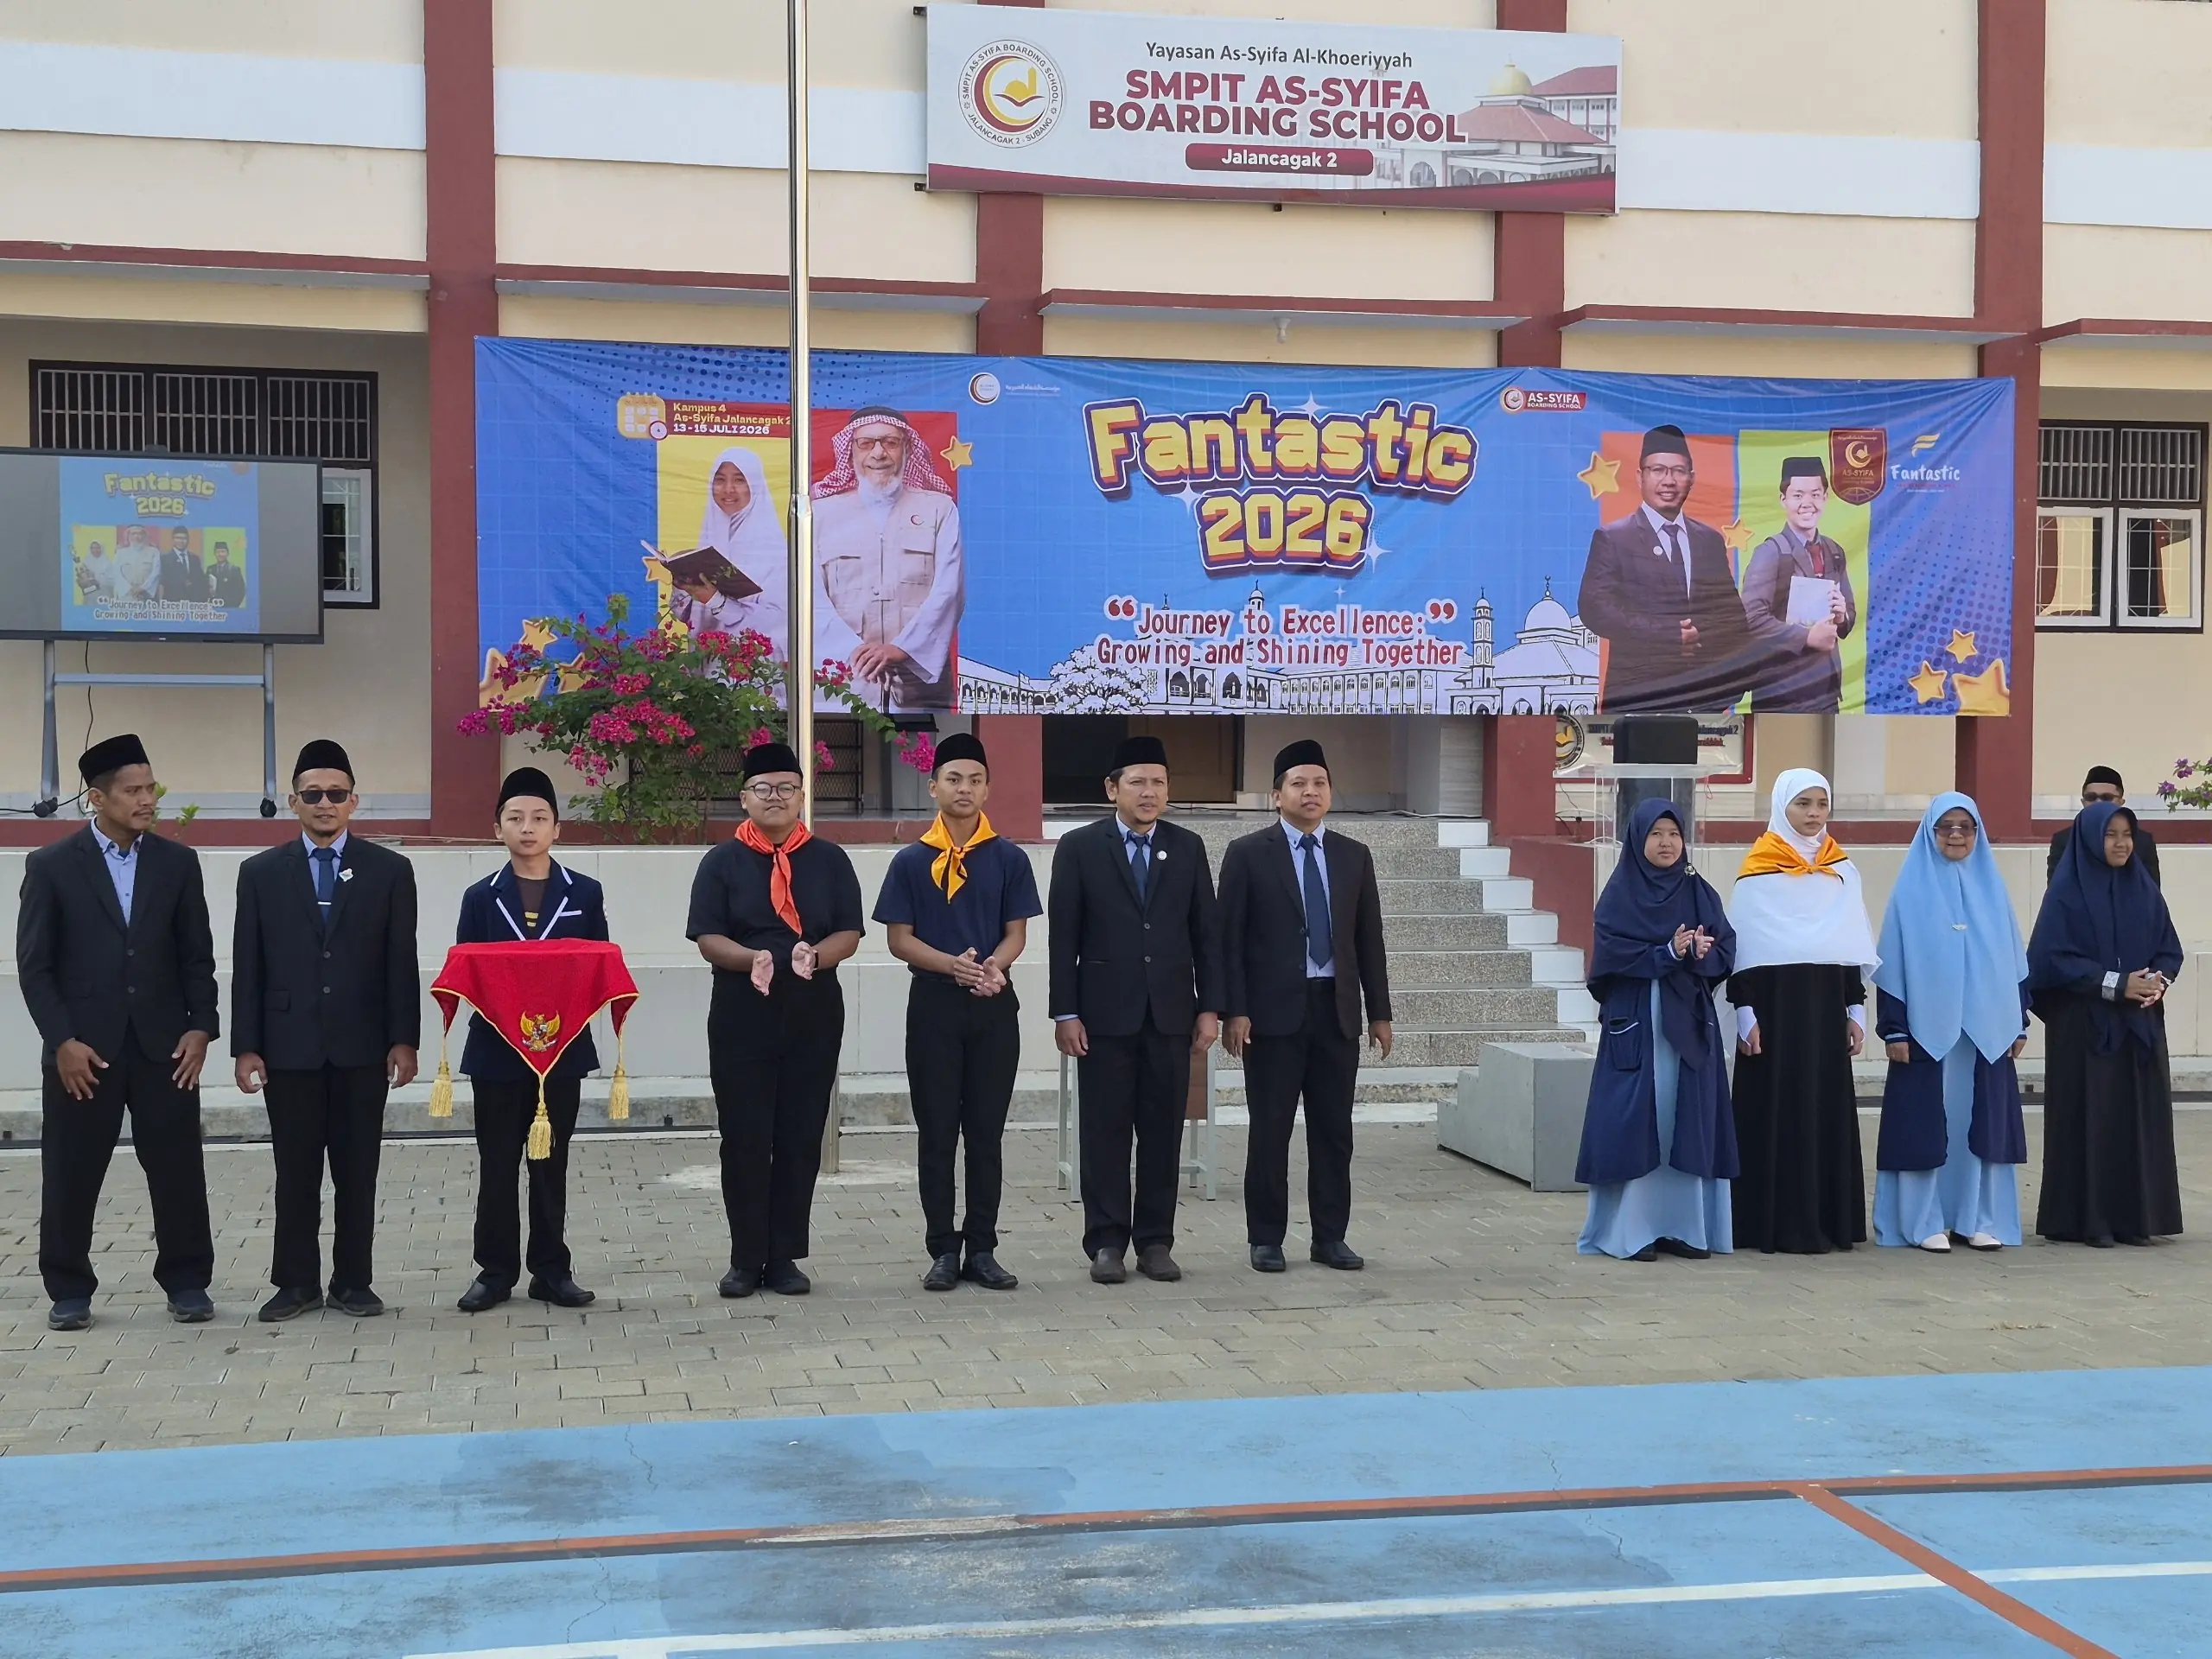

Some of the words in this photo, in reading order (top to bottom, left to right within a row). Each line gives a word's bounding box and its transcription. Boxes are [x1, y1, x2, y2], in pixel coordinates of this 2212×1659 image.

[1146, 41, 1215, 61] Yayasan
[1220, 45, 1287, 65] As-Syifa
[1293, 48, 1413, 71] Al-Khoeriyyah
[963, 73, 972, 99] SMPIT
[969, 45, 1001, 72] AS-SYIFA
[1003, 44, 1046, 67] BOARDING
[1045, 67, 1059, 104] SCHOOL
[1126, 69, 1245, 102] SMPIT
[1255, 74, 1430, 110] AS-SYIFA
[968, 113, 1014, 144] JALANCAGAK
[1025, 117, 1052, 142] SUBANG
[1090, 100, 1297, 137] BOARDING
[1309, 109, 1466, 143] SCHOOL
[1221, 149, 1322, 170] Jalancagak
[1326, 151, 1338, 168] 2
[674, 403, 716, 414] Kampus
[718, 404, 726, 412] 4
[1529, 392, 1580, 404] AS-SYIFA
[673, 423, 686, 432] 13
[709, 424, 739, 434] JULI
[674, 413, 721, 424] As-Syifa
[722, 415, 784, 426] Jalancagak
[1085, 395, 1476, 488] Fantastic
[105, 472, 216, 497] Fantastic
[1891, 464, 1961, 481] Fantastic
[136, 496, 184, 516] 2026
[1198, 491, 1372, 565] 2026
[95, 609, 129, 620] Growing
[133, 610, 148, 619] and
[152, 611, 185, 620] Shining
[189, 612, 226, 621] Together
[1244, 608, 1270, 634] to
[1098, 638, 1191, 666] Growing
[1205, 639, 1244, 664] and
[1257, 638, 1349, 667] Shining
[1362, 638, 1463, 667] Together
